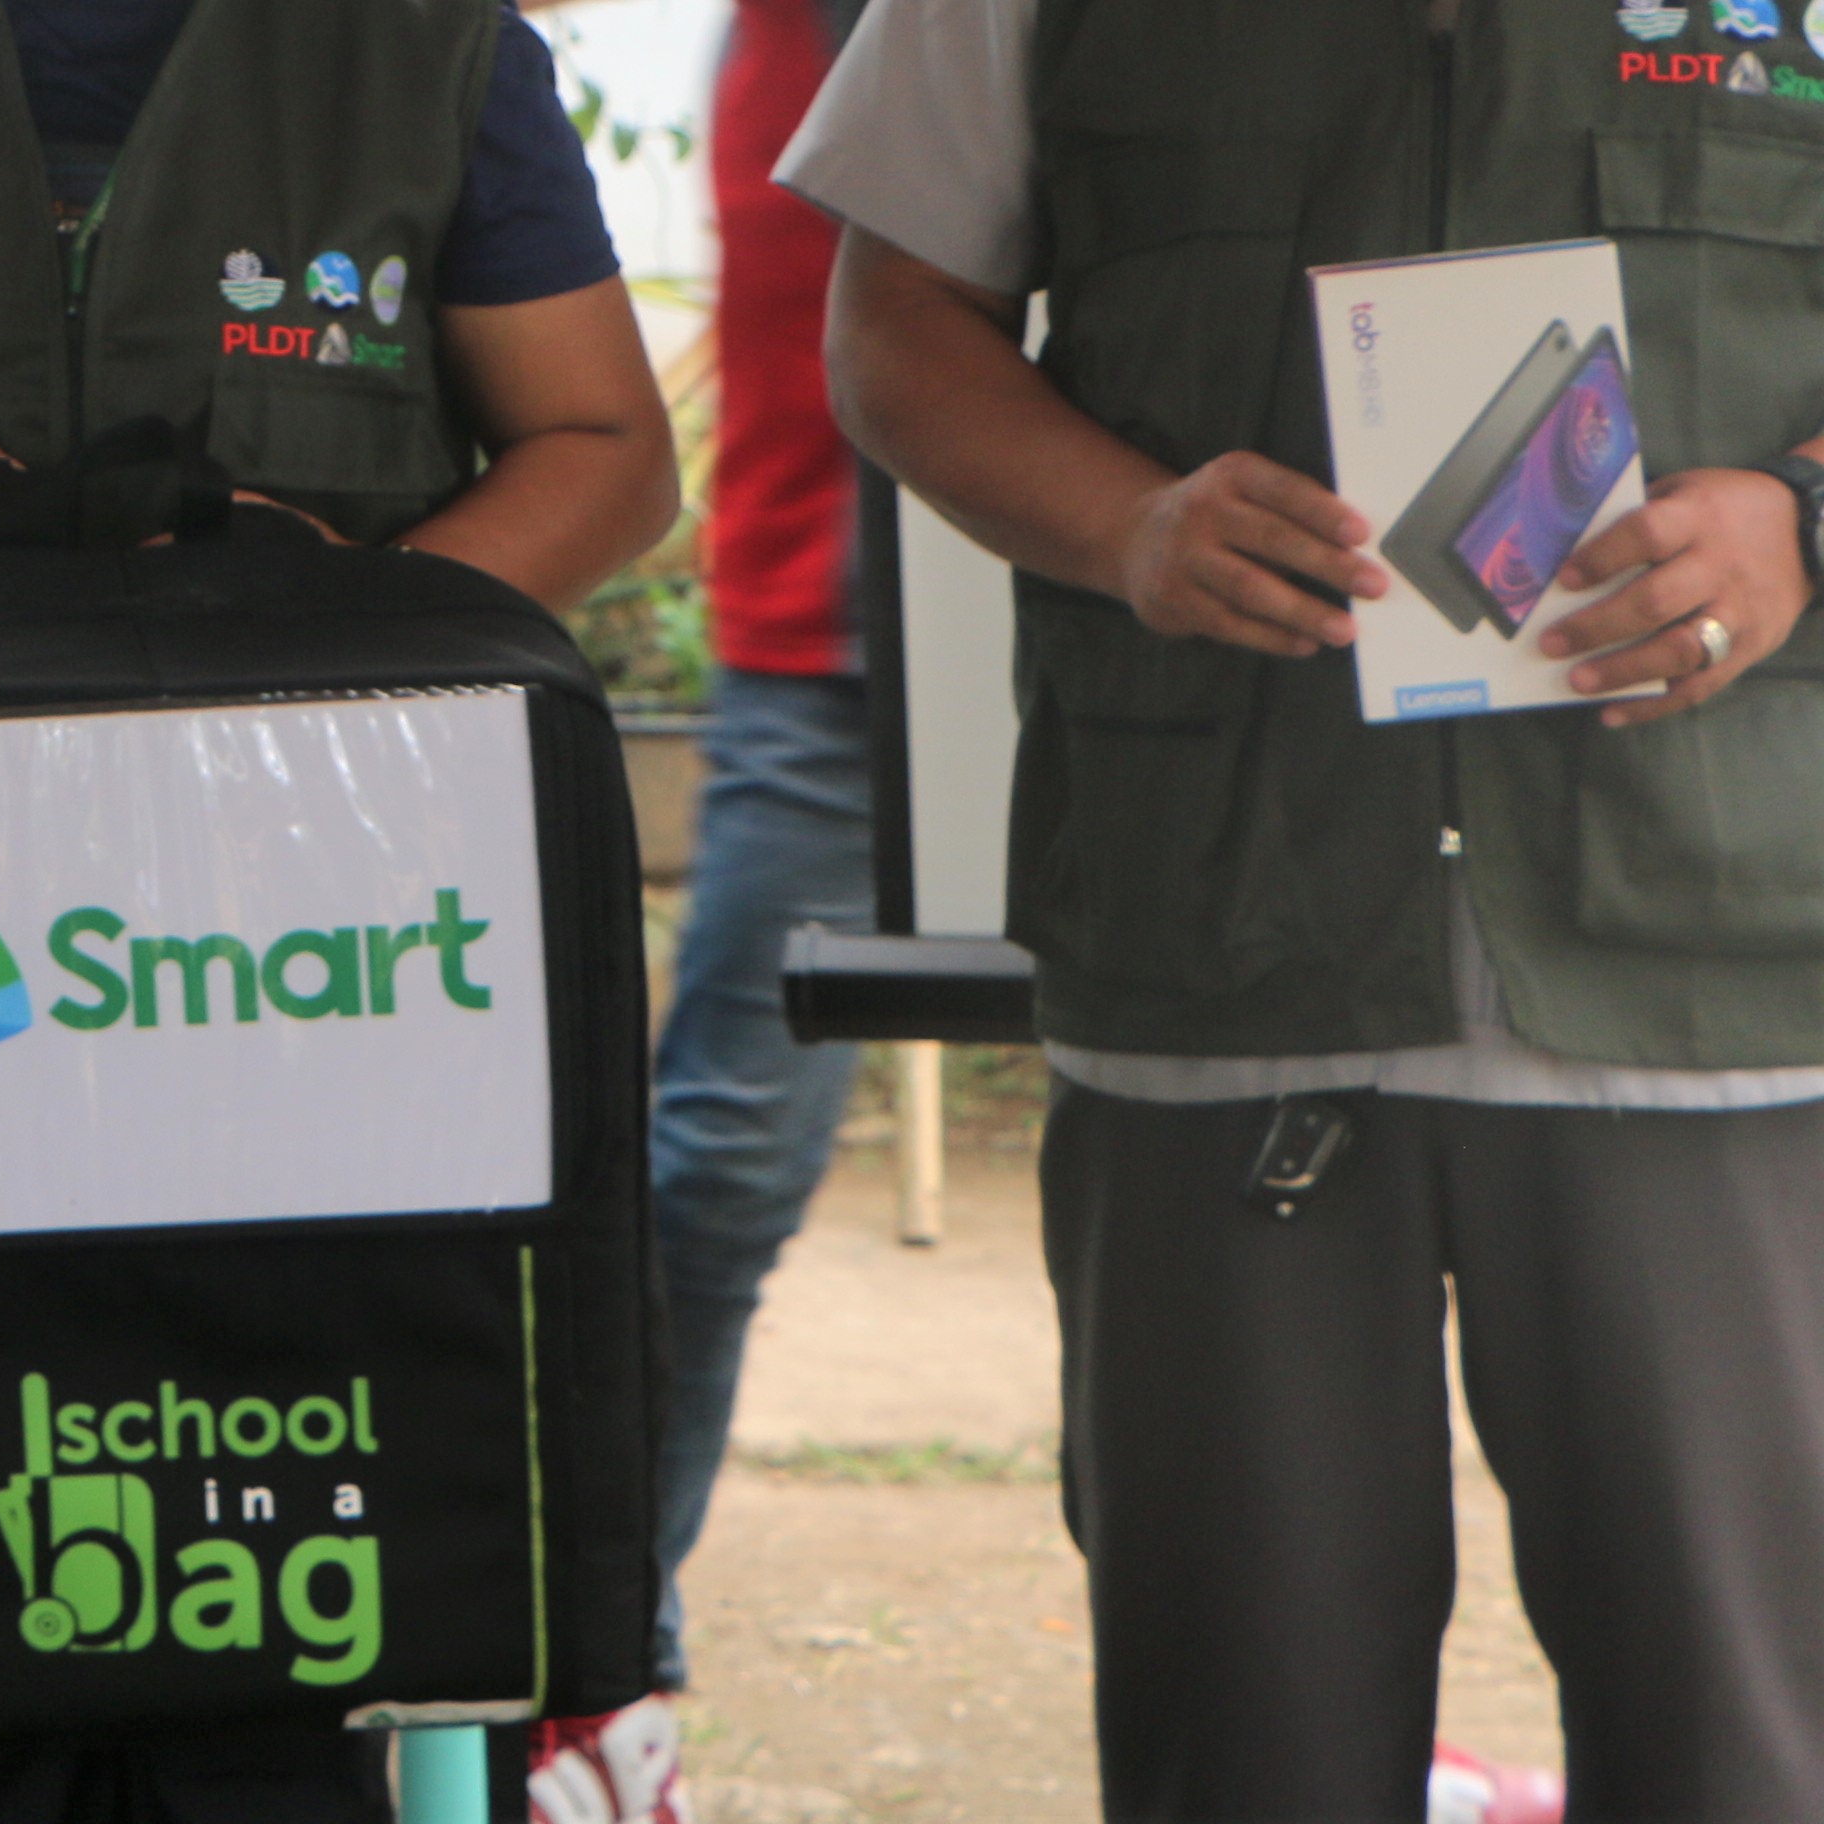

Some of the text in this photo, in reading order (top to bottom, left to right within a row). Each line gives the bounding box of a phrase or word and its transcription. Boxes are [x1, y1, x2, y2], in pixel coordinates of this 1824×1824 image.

[1619, 51, 1725, 86] PLDT
[221, 322, 317, 359] PLDT
[1399, 685, 1484, 713] Lenovo
[46, 886, 493, 1031] Smart
[55, 1376, 379, 1465] school
[203, 1477, 364, 1523] in a
